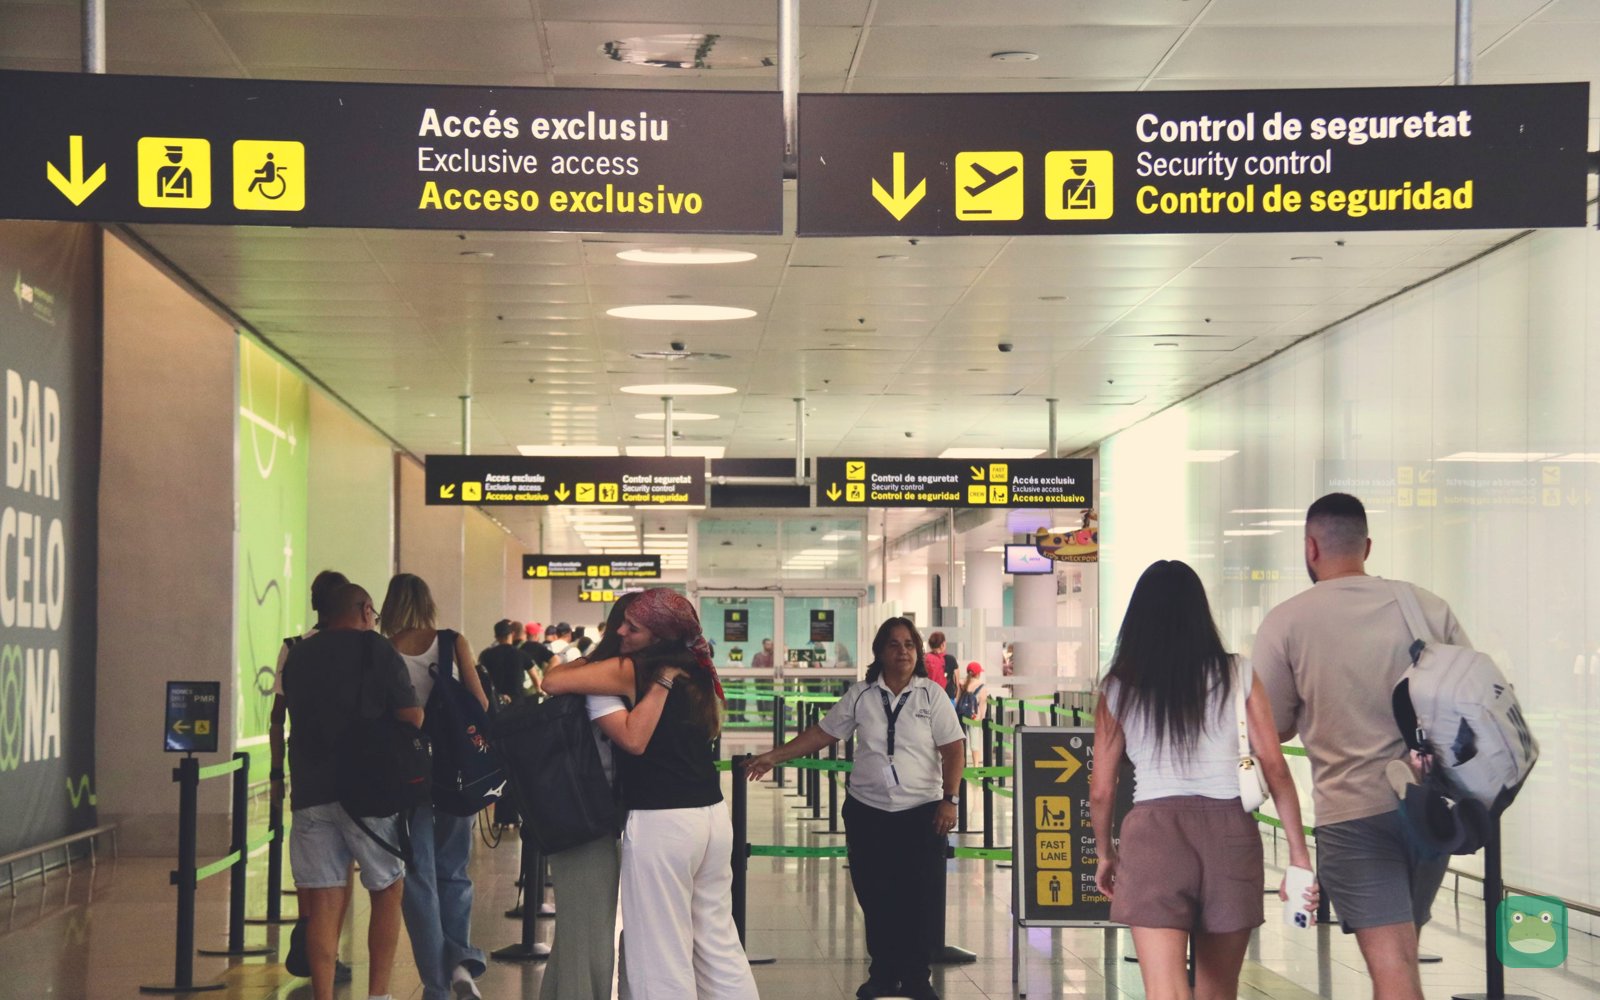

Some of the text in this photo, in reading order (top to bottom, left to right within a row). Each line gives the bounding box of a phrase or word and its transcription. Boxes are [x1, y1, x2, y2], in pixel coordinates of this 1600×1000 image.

[418, 108, 669, 141] Accés exclusiu
[1135, 110, 1472, 146] Control de seguretat
[418, 147, 639, 176] Exclusive access
[1136, 149, 1332, 181] Security control
[418, 181, 703, 215] Acceso exclusivo
[1135, 180, 1473, 217] Control de seguridad
[6, 368, 60, 501] BAR
[622, 474, 653, 484] Control
[871, 473, 959, 484] Control de seguretat
[1040, 476, 1075, 485] exclusiu
[622, 493, 689, 504] Control seguridad
[870, 491, 960, 502] Control de seguridad
[1012, 493, 1086, 503] Acceso exclusivo
[1061, 554, 1098, 562] CHECKPOIN
[0, 506, 66, 631] CELO
[193, 695, 215, 703] PMR
[1040, 840, 1066, 850] FAST
[1040, 852, 1068, 861] LANE
